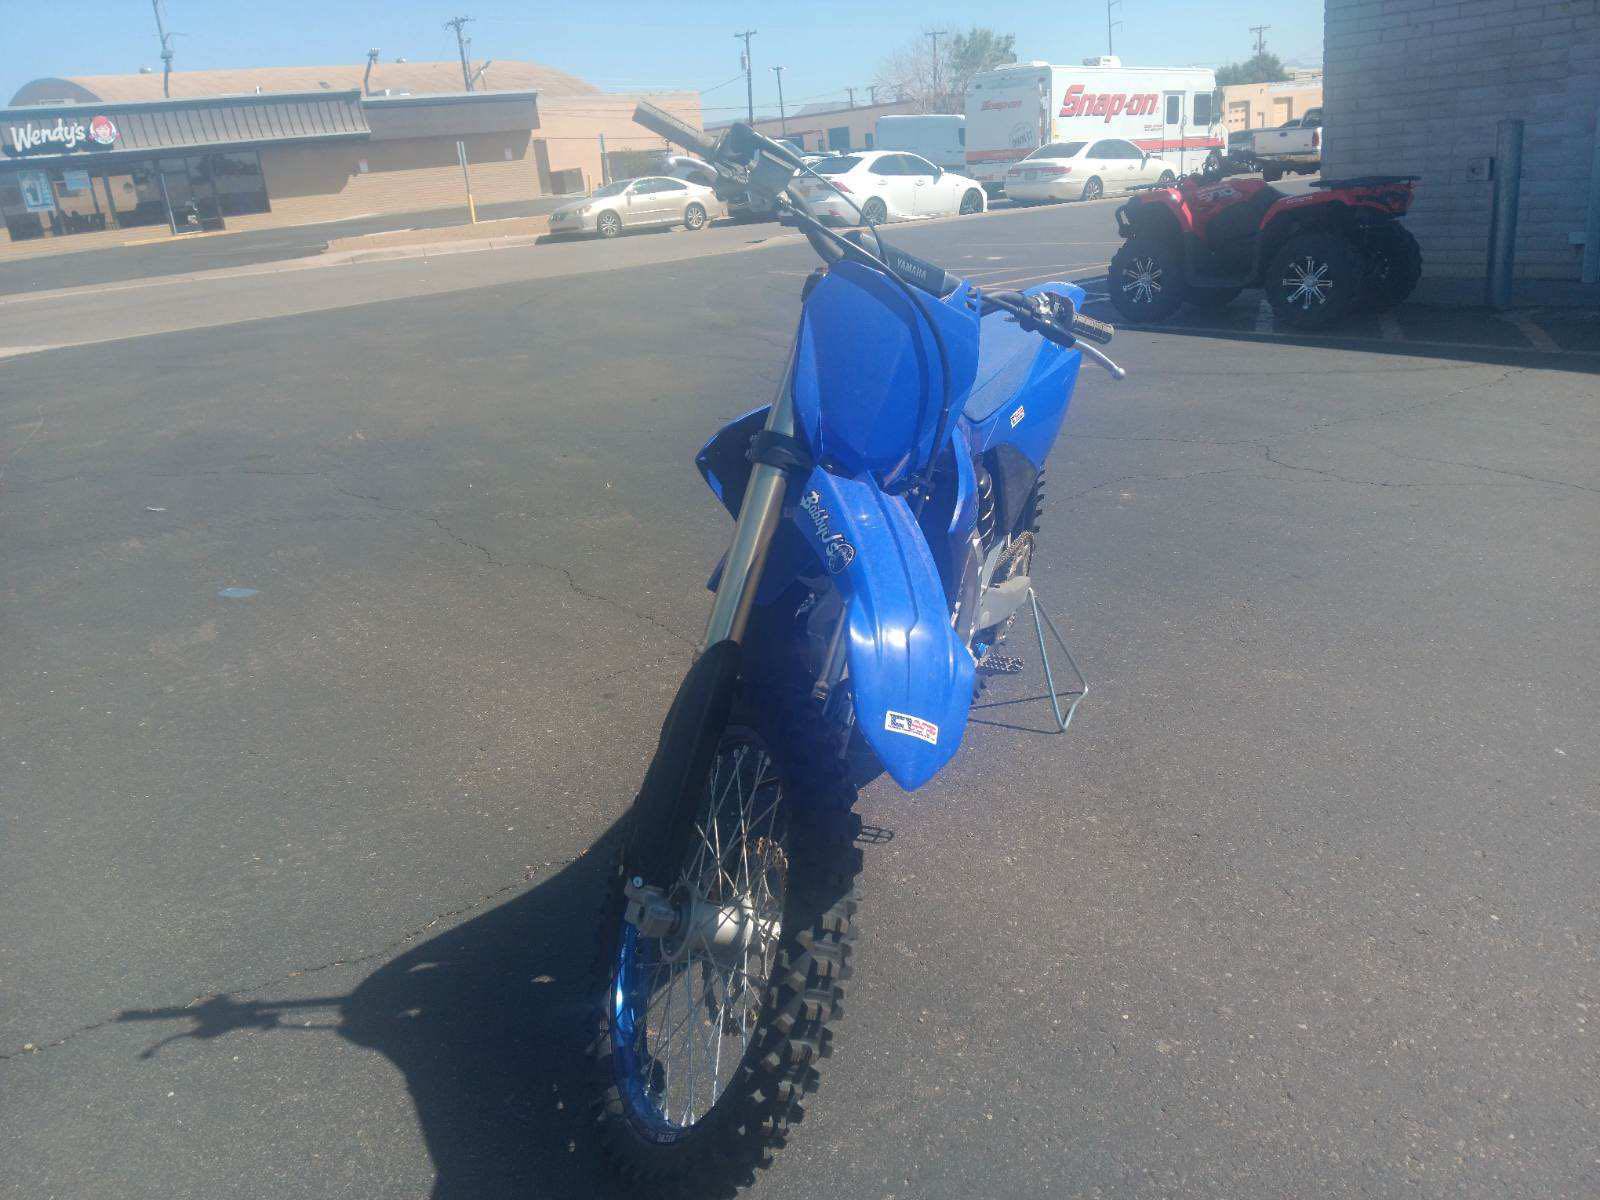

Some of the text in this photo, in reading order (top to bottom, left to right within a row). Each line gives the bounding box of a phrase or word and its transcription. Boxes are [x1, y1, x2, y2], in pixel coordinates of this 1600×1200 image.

[1058, 84, 1160, 123] Snap-on
[10, 118, 86, 152] Wendy's
[896, 257, 927, 281] YAMAHA
